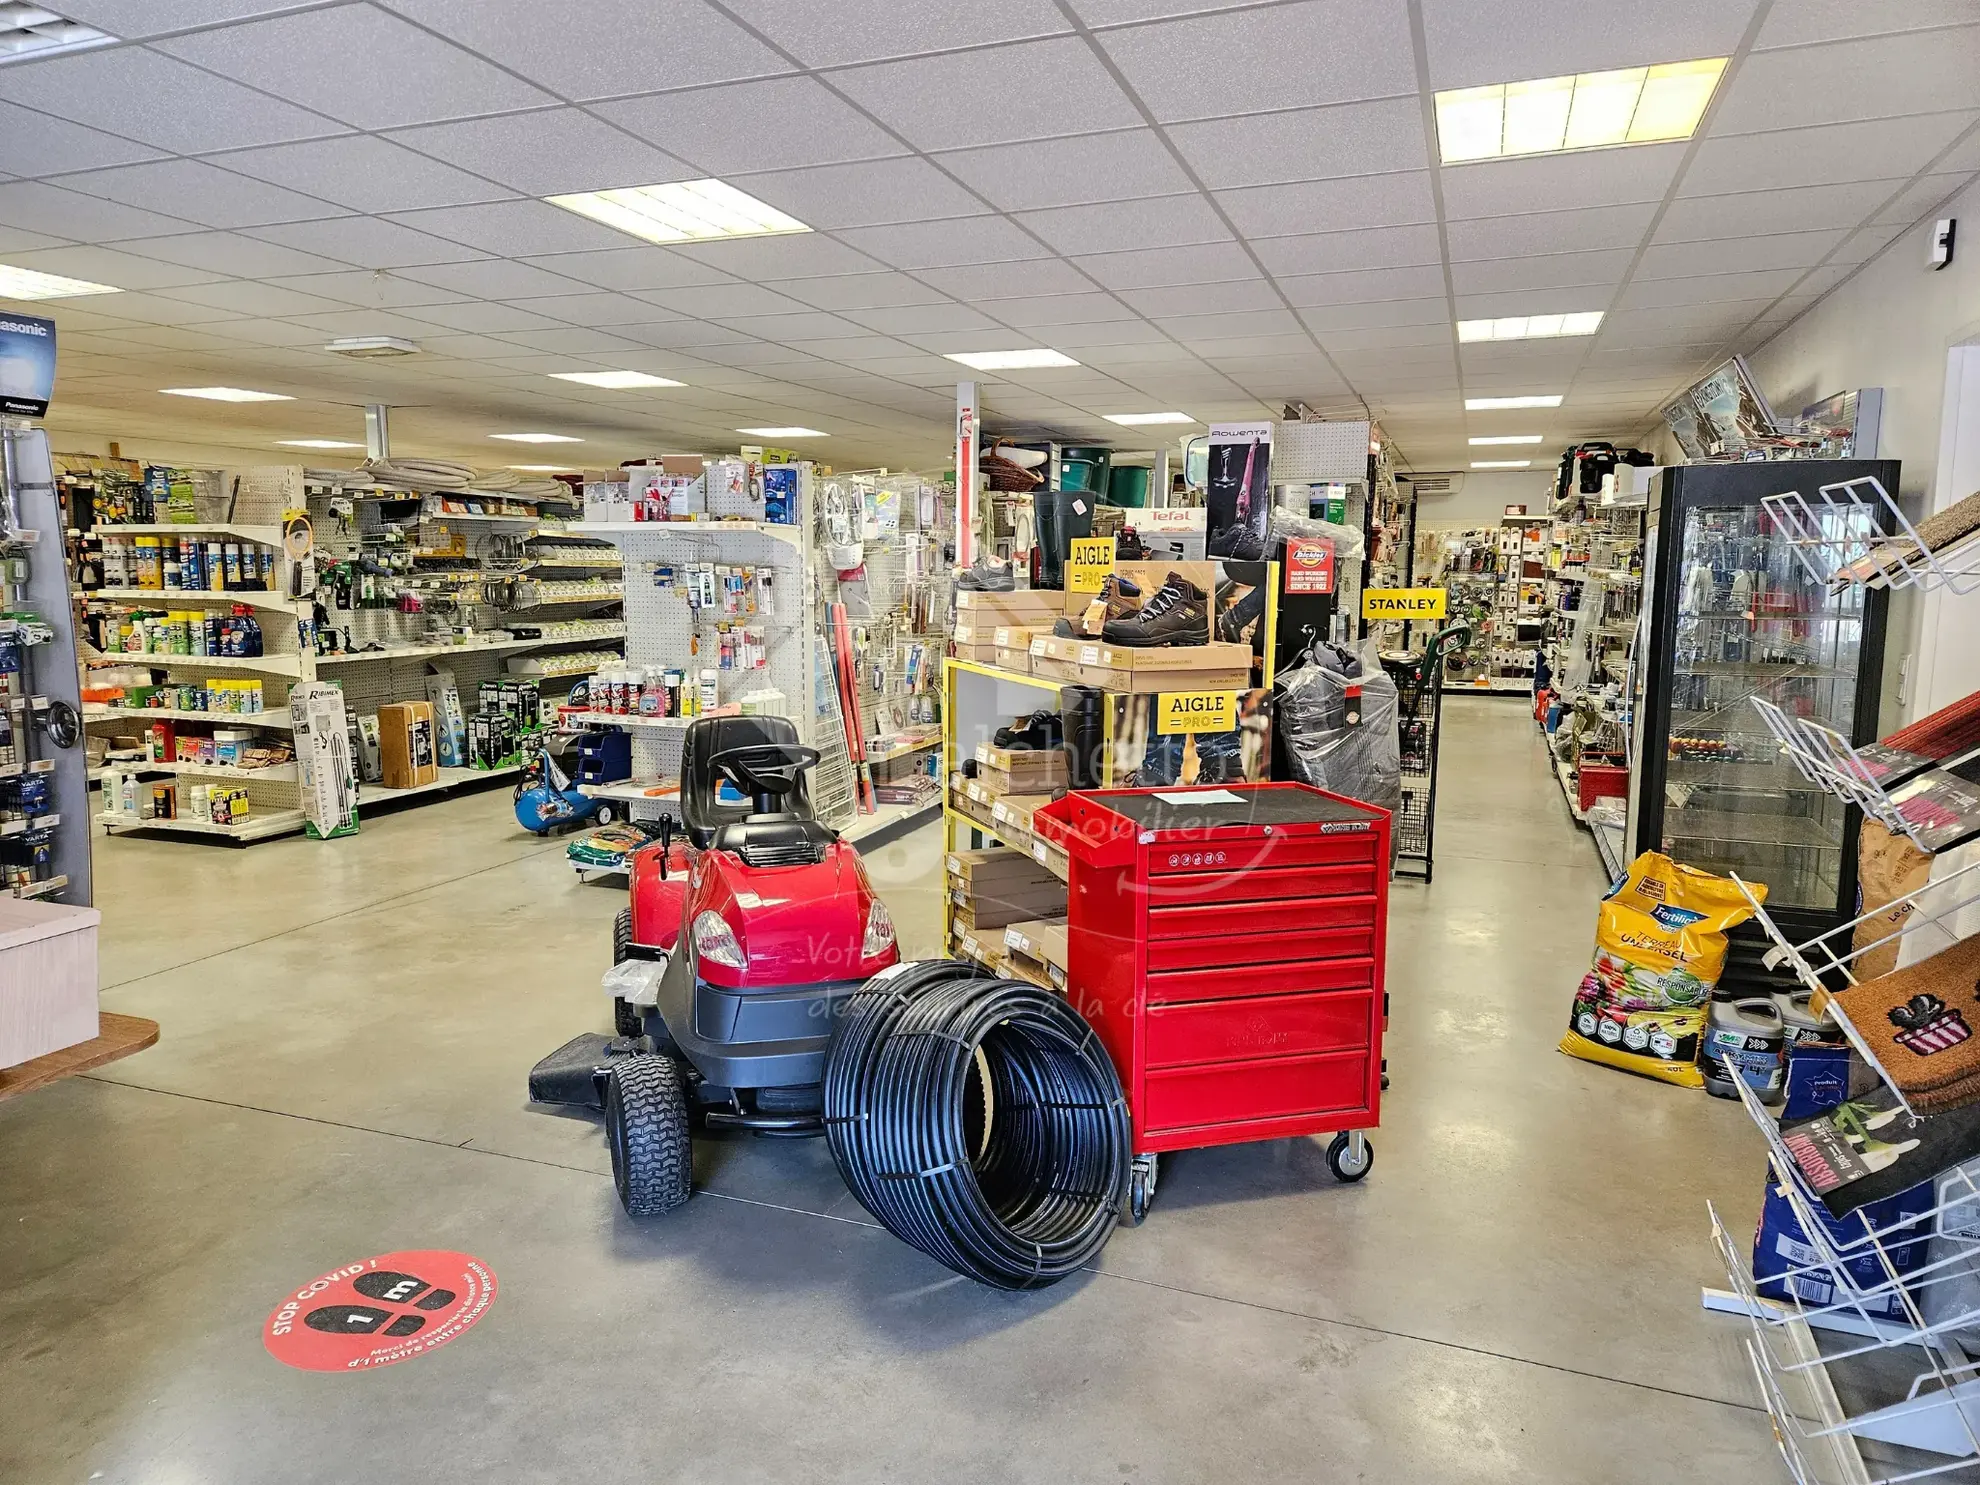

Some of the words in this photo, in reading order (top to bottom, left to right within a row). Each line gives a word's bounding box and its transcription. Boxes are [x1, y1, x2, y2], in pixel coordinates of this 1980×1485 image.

[1211, 429, 1268, 437] Rowenta
[1152, 511, 1192, 521] Tefal
[1074, 545, 1111, 565] AIGLE
[1296, 551, 1325, 559] Dickies
[1082, 571, 1101, 587] PRO
[1369, 599, 1437, 610] STANLEY
[1171, 697, 1225, 713] AIGLE
[1183, 716, 1211, 728] PRO
[21, 779, 45, 788] VARTA
[25, 834, 49, 842] VARTA
[1621, 933, 1688, 962] UNERSEL
[467, 1261, 494, 1293] personne
[273, 1302, 301, 1336] STOP
[297, 1263, 364, 1300] COVID
[462, 1292, 490, 1325] chaque
[347, 1314, 374, 1324] 1
[426, 1323, 463, 1347] entre
[370, 1343, 403, 1356] Merci
[405, 1338, 419, 1347] de
[374, 1345, 423, 1364] mètre
